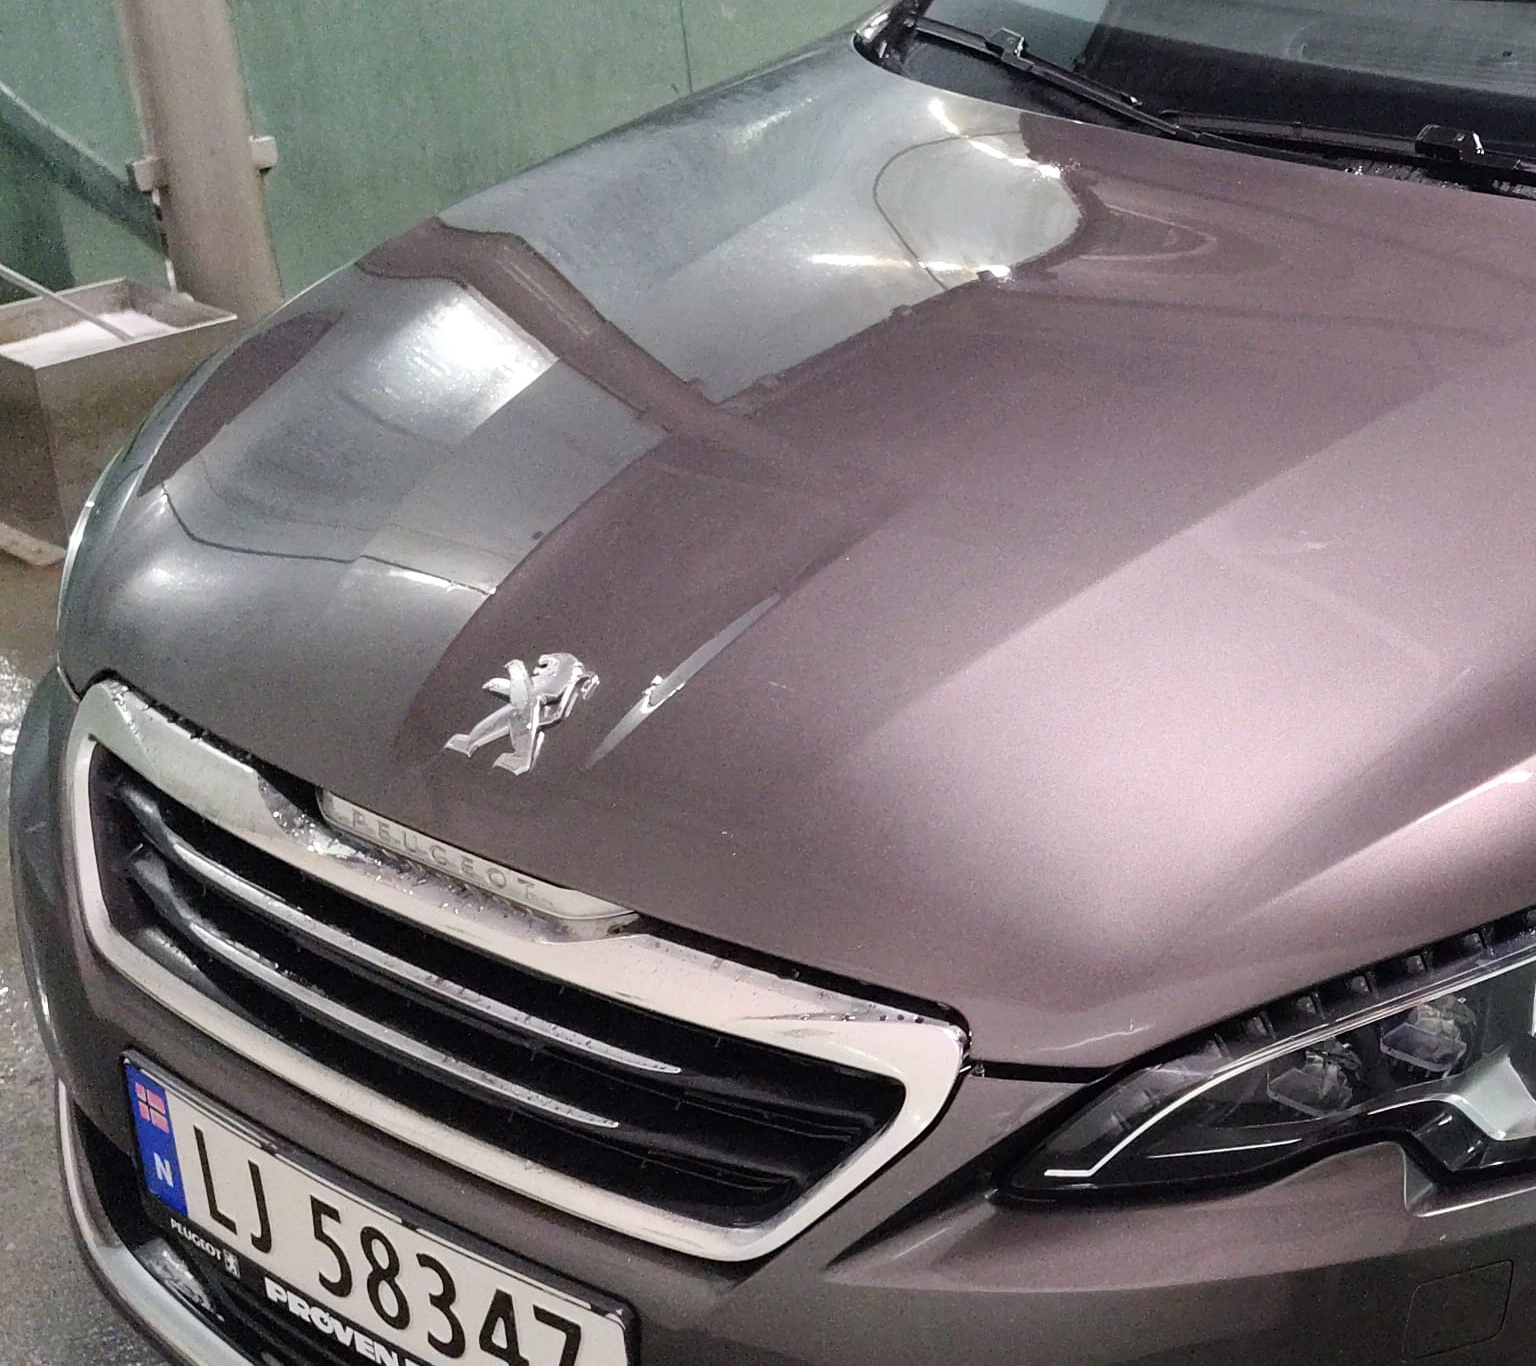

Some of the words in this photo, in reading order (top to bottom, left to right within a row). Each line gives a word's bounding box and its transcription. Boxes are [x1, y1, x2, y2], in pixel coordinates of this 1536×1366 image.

[352, 808, 536, 900] PEUGEOT
[153, 1152, 174, 1188] N
[194, 1124, 273, 1255] LJ
[170, 1217, 222, 1261] PEUGEOT
